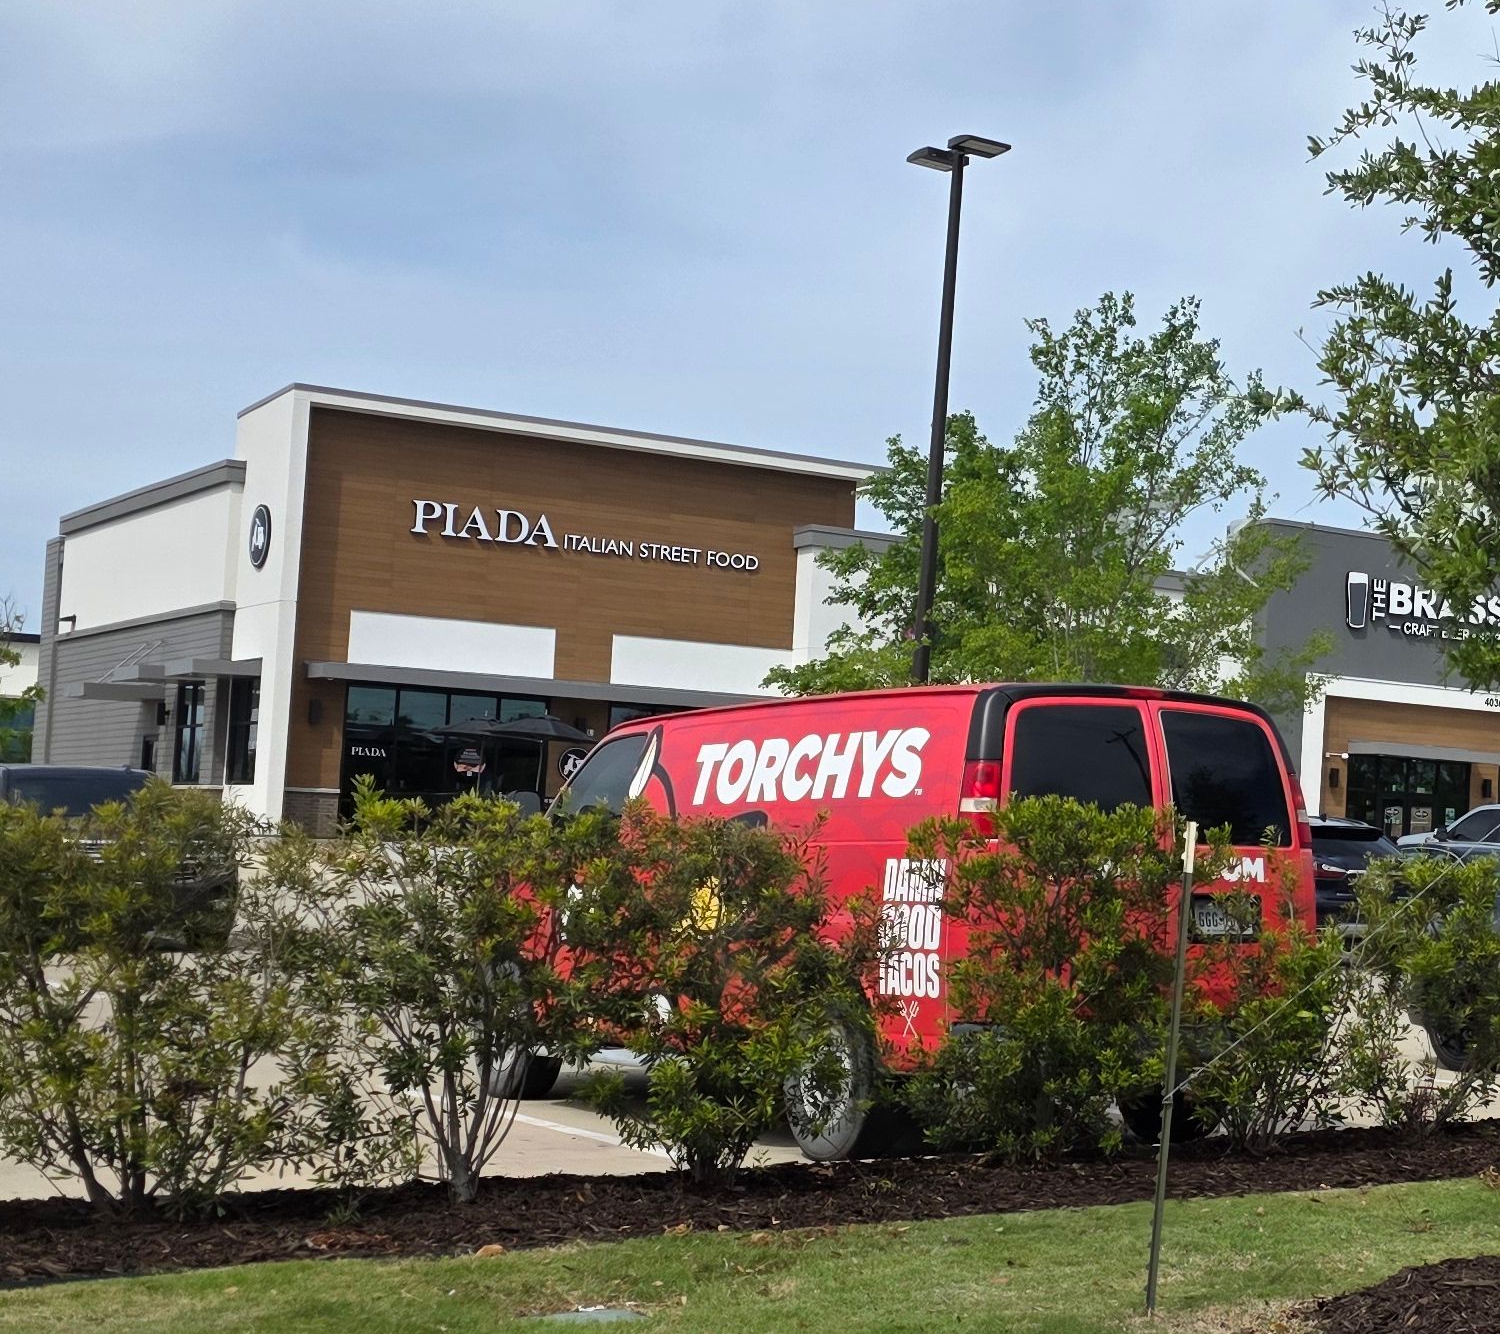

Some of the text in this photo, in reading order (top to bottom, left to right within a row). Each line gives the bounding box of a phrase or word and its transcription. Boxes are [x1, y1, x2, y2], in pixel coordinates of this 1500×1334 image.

[410, 499, 759, 571] PIADA ITALIAN STREET FOOD
[1372, 578, 1387, 621] THE
[351, 746, 387, 758] PIADA
[692, 727, 931, 806] TORCHYS
[882, 858, 947, 903] DAMN
[877, 951, 940, 999] TACOS
